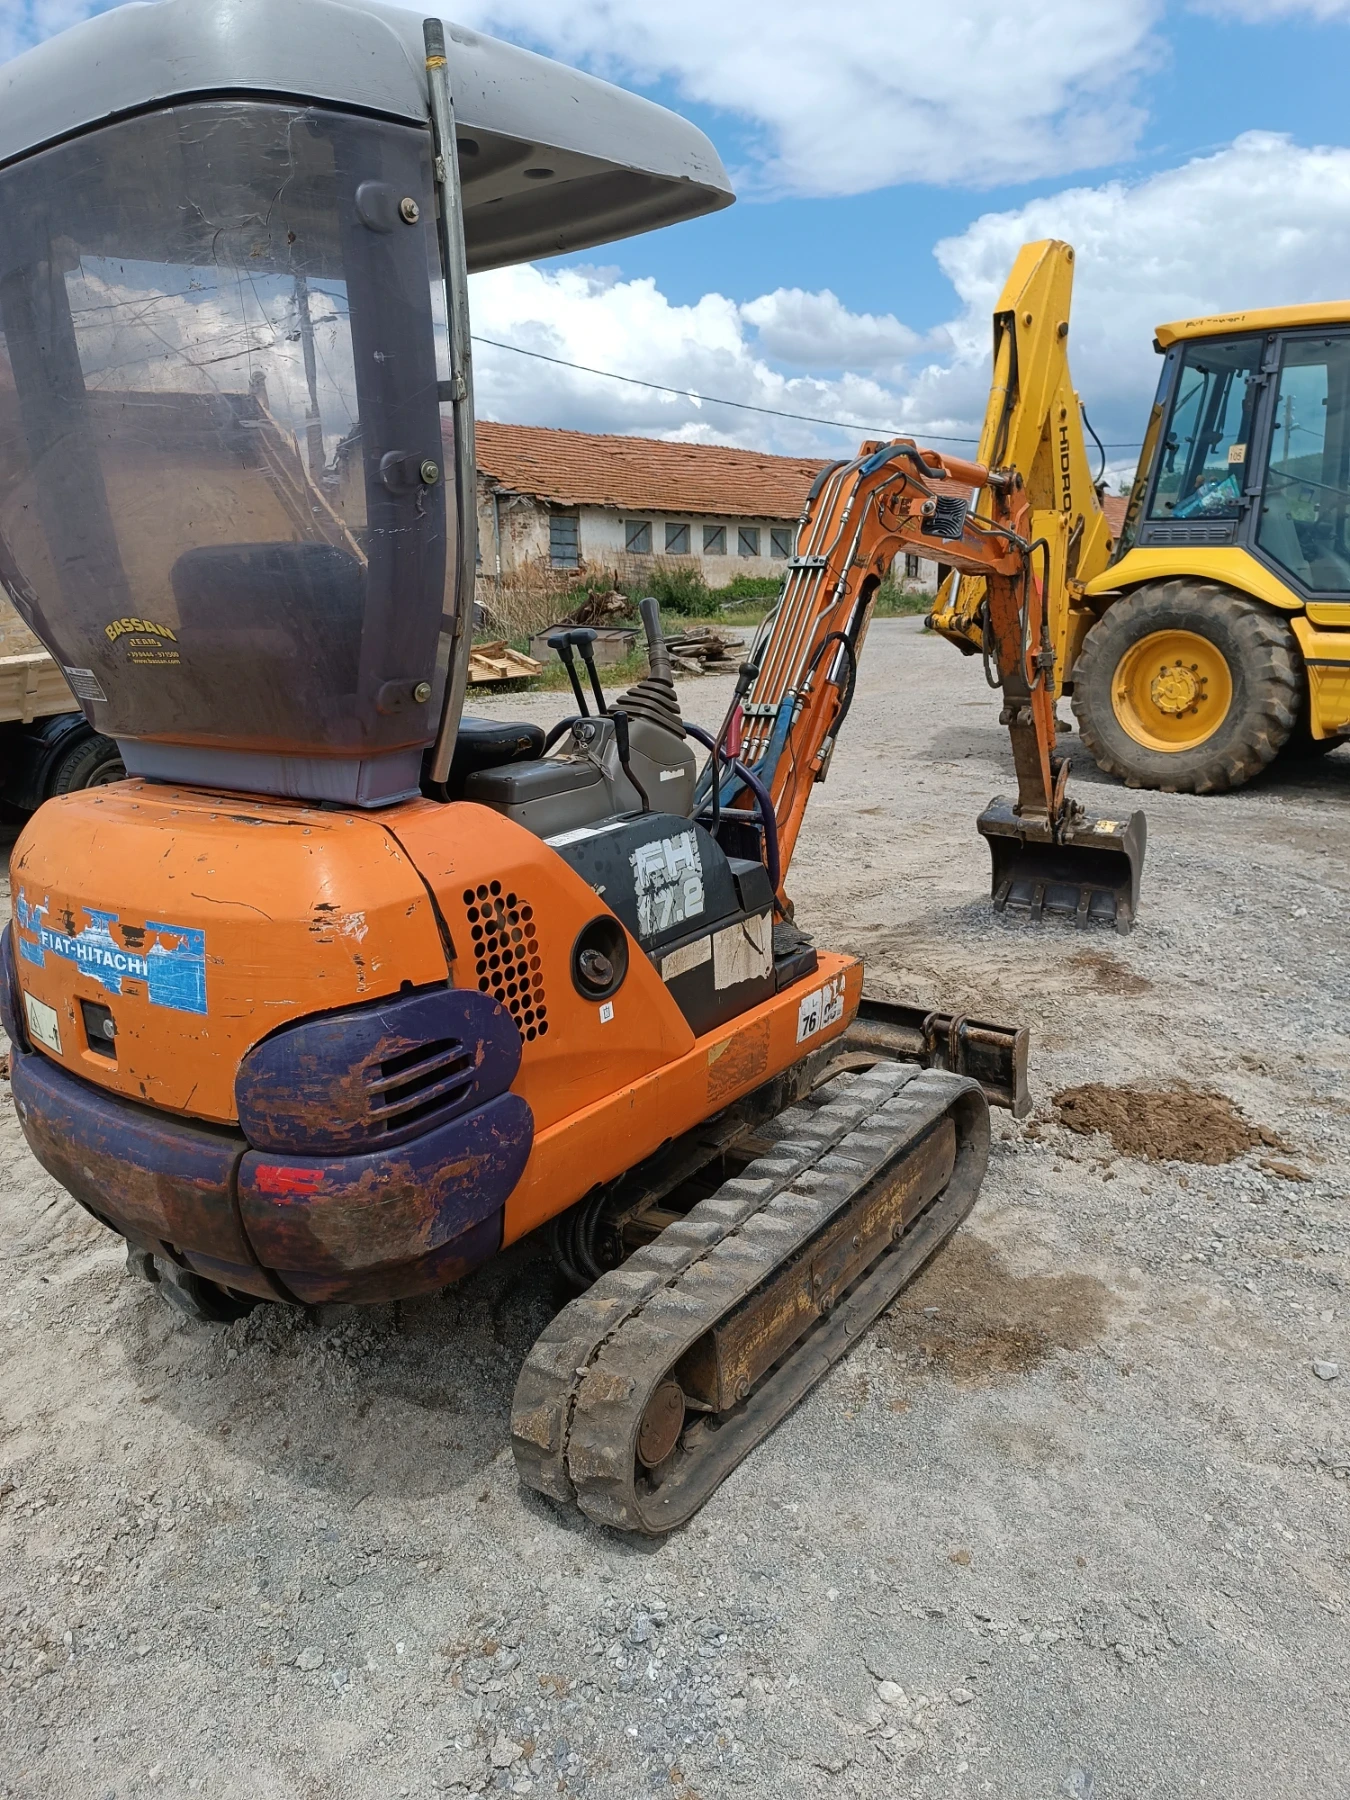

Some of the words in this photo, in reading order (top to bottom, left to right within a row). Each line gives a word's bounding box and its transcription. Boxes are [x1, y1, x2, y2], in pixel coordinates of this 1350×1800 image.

[104, 617, 178, 642] BASSAN
[129, 638, 160, 646] TEAM
[635, 831, 697, 890] FH
[41, 932, 149, 977] FIAT-HITACHI
[803, 1011, 817, 1037] 76
